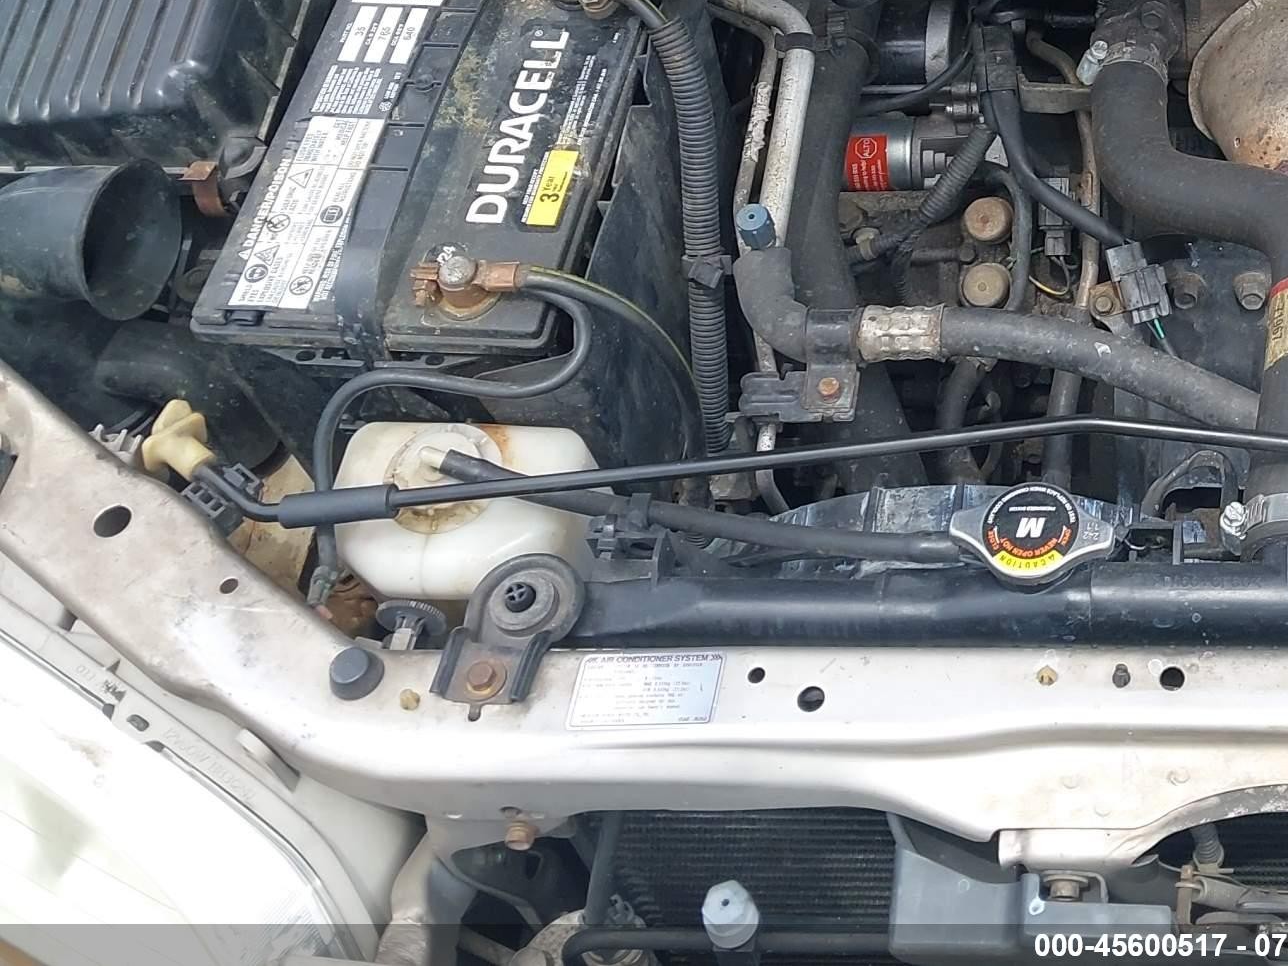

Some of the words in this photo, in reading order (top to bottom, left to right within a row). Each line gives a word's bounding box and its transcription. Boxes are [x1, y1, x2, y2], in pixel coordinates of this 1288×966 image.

[352, 25, 366, 36] 35
[242, 158, 292, 246] DANGER/POISON
[538, 193, 559, 202] 3
[1015, 517, 1046, 537] M
[1011, 547, 1033, 557] OPEN
[1034, 537, 1057, 555] NEVER
[998, 554, 1045, 568] CAUTION
